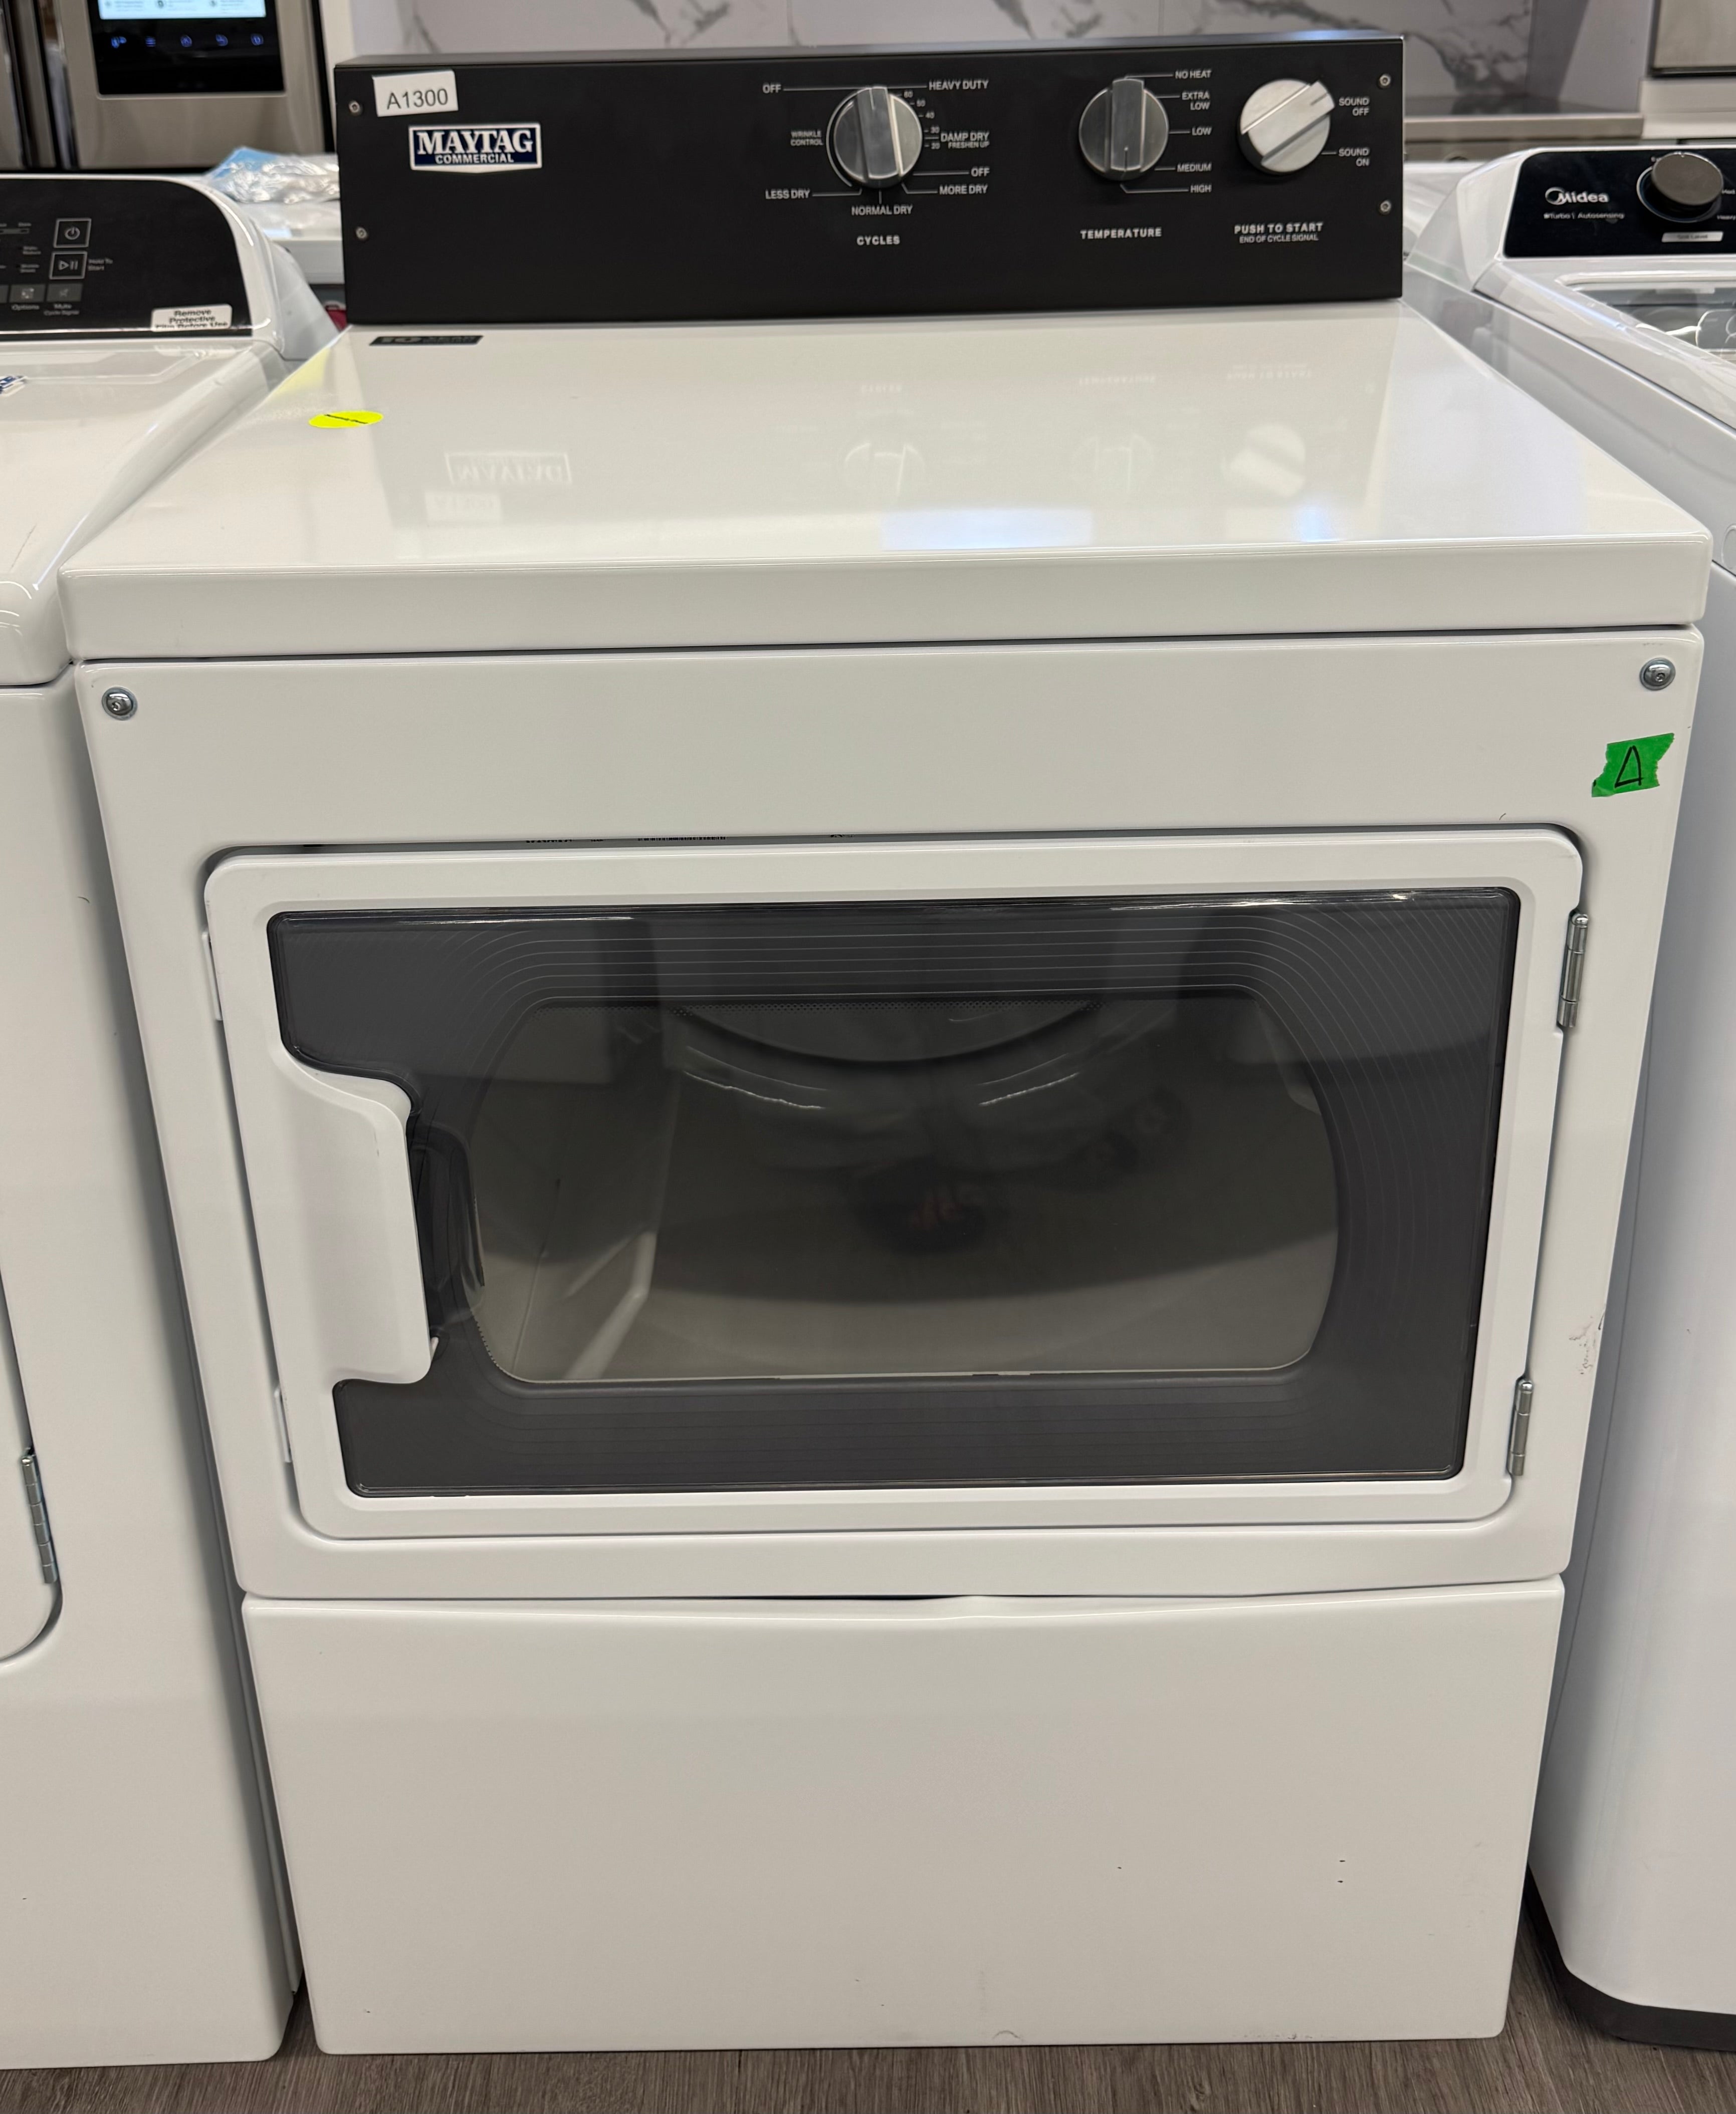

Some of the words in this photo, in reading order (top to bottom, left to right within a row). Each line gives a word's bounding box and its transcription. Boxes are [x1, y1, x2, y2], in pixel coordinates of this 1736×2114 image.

[1175, 71, 1188, 79] NO
[1190, 70, 1211, 78] HEAT
[763, 84, 781, 93] OFF
[929, 81, 961, 90] HEAVY
[963, 80, 988, 89] DUTY
[387, 89, 448, 110] A1300
[1182, 91, 1209, 101] EXTRA
[1191, 102, 1210, 110] LOW
[1339, 97, 1369, 106] SOUND
[1353, 107, 1369, 116] OFF
[791, 130, 822, 138] WRINKLE
[1192, 127, 1212, 135] LOW
[791, 137, 823, 146] CONTROL
[941, 132, 968, 142] DAMP
[970, 132, 989, 141] DRY
[417, 130, 533, 154] MAYTAG
[1339, 148, 1369, 157] SOUND
[435, 154, 514, 164] COMMERCIAL
[1356, 158, 1369, 166] ON
[971, 167, 989, 176] OFF
[1177, 163, 1211, 172] MEDIUM
[940, 185, 969, 194] MORE
[969, 185, 987, 194] DRY
[1191, 184, 1211, 192] HIGH
[766, 189, 789, 199] LESS
[791, 189, 810, 198] DRY
[1545, 186, 1609, 205] Midea
[851, 206, 892, 215] NORMAL
[894, 205, 913, 214] DRY
[1080, 227, 1161, 239] TEMPERATURE
[1235, 225, 1266, 234] PUSH
[1267, 224, 1283, 234] TO
[1286, 223, 1323, 233] START
[857, 236, 900, 245] CYCLES
[1268, 233, 1291, 242] CYCLE
[1292, 232, 1319, 241] SIGNAL
